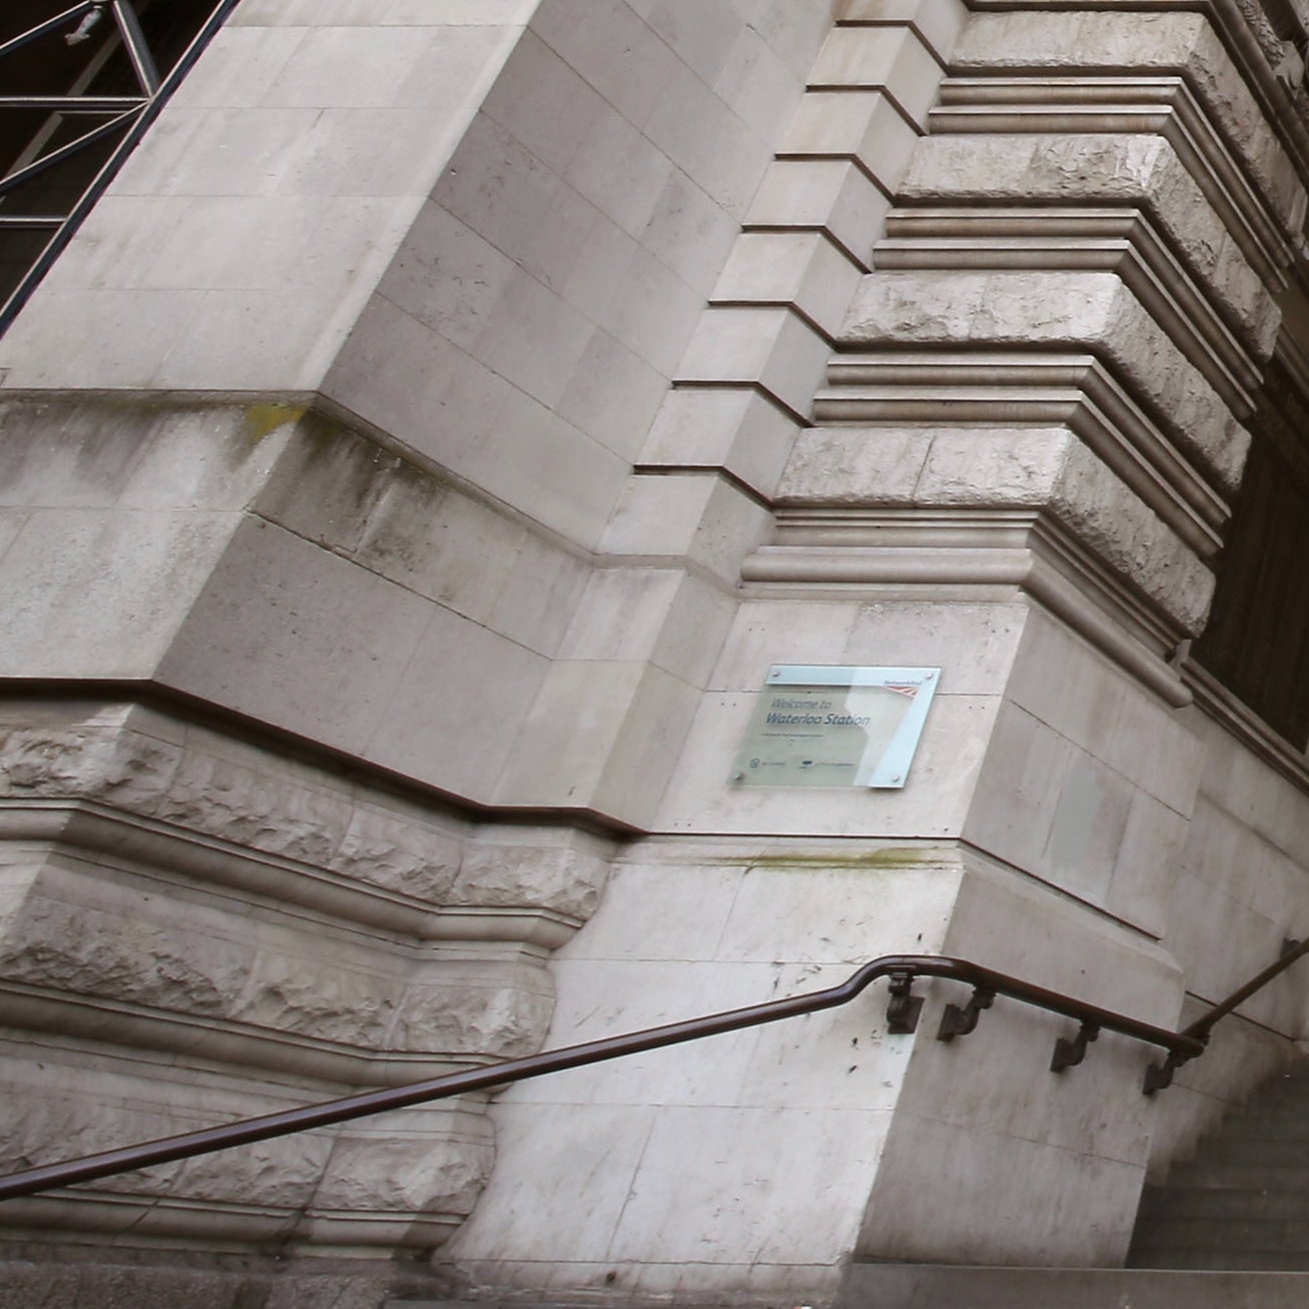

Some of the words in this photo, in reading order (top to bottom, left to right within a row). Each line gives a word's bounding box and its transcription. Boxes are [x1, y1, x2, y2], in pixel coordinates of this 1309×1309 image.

[771, 698, 819, 710] Welcome
[821, 699, 832, 710] to
[766, 712, 822, 725] Waterloo
[824, 713, 871, 726] Station
